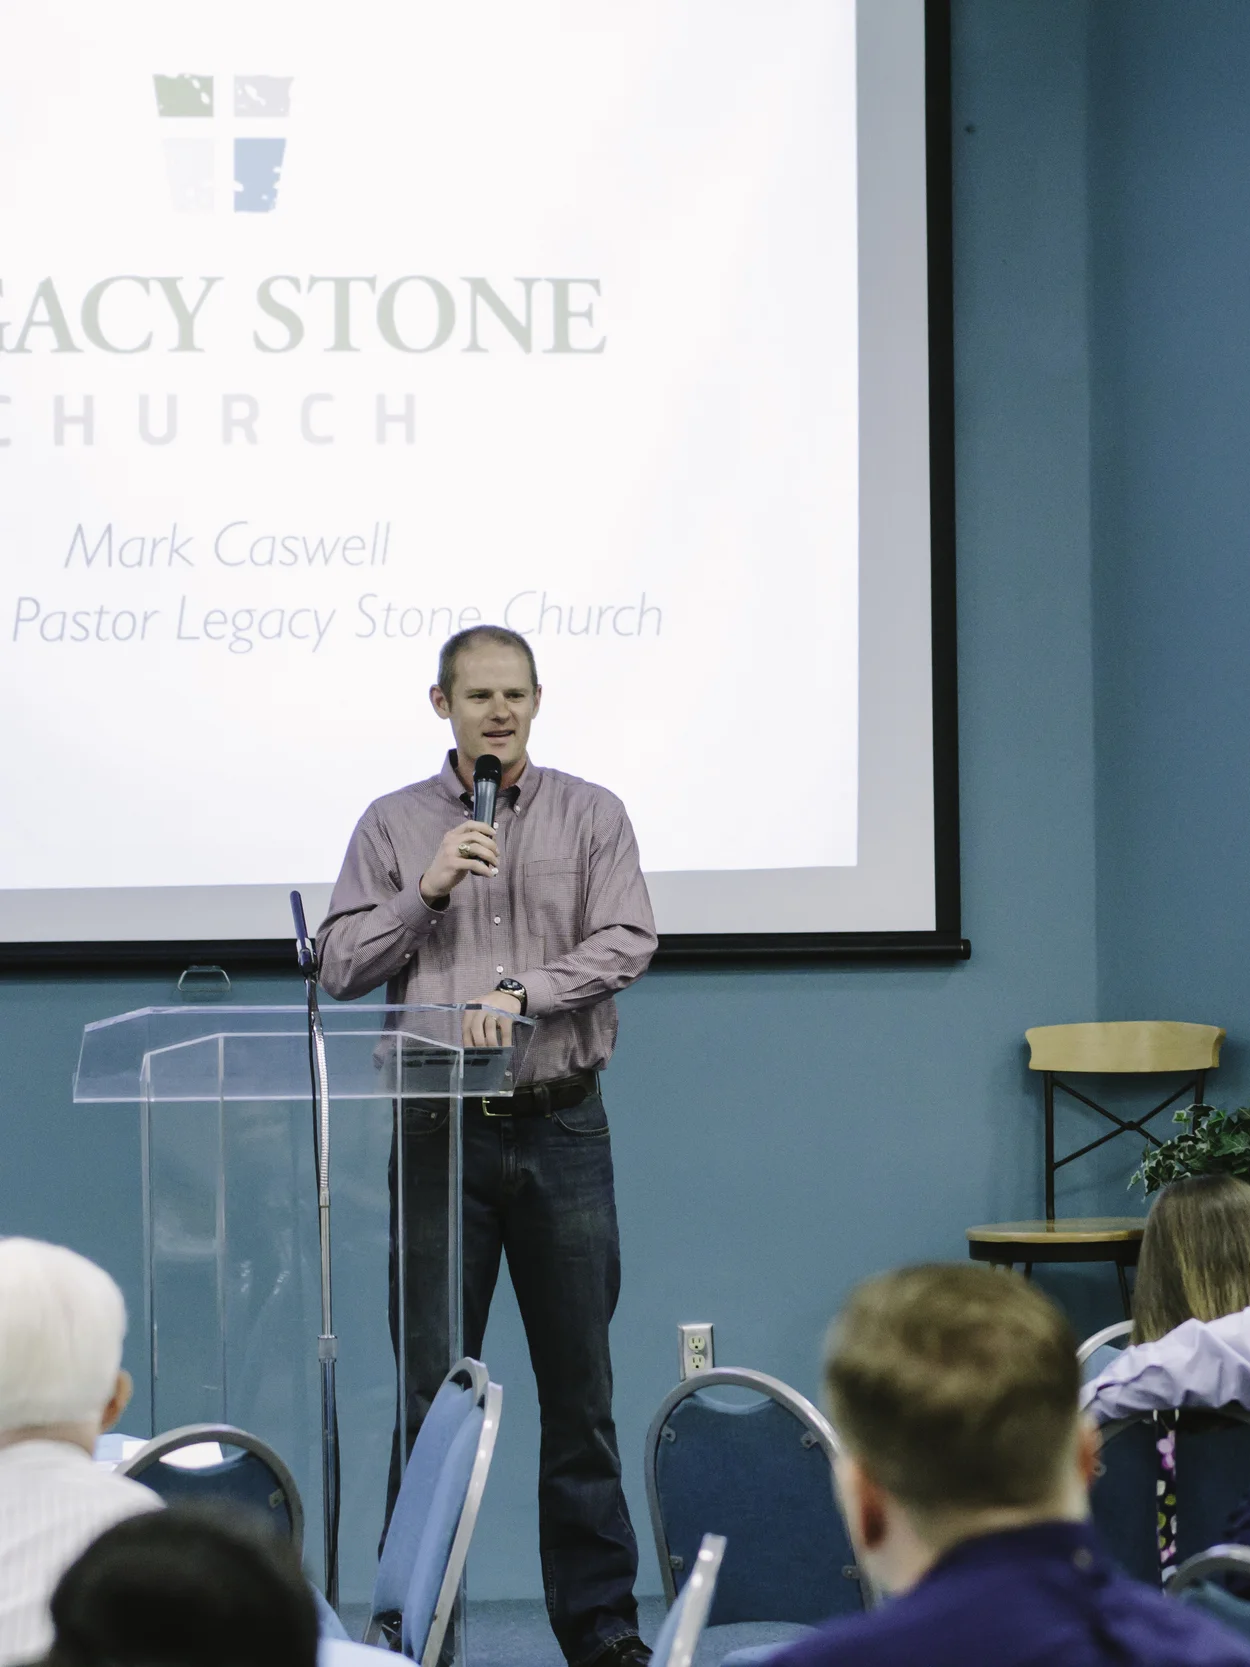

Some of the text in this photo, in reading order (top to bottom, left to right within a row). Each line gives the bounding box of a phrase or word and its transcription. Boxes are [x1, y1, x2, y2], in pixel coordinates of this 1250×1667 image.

[0, 274, 607, 356] ACY STONE
[63, 520, 392, 569] Mark Caswell
[12, 590, 662, 654] Pastor Legacy Stone Church
